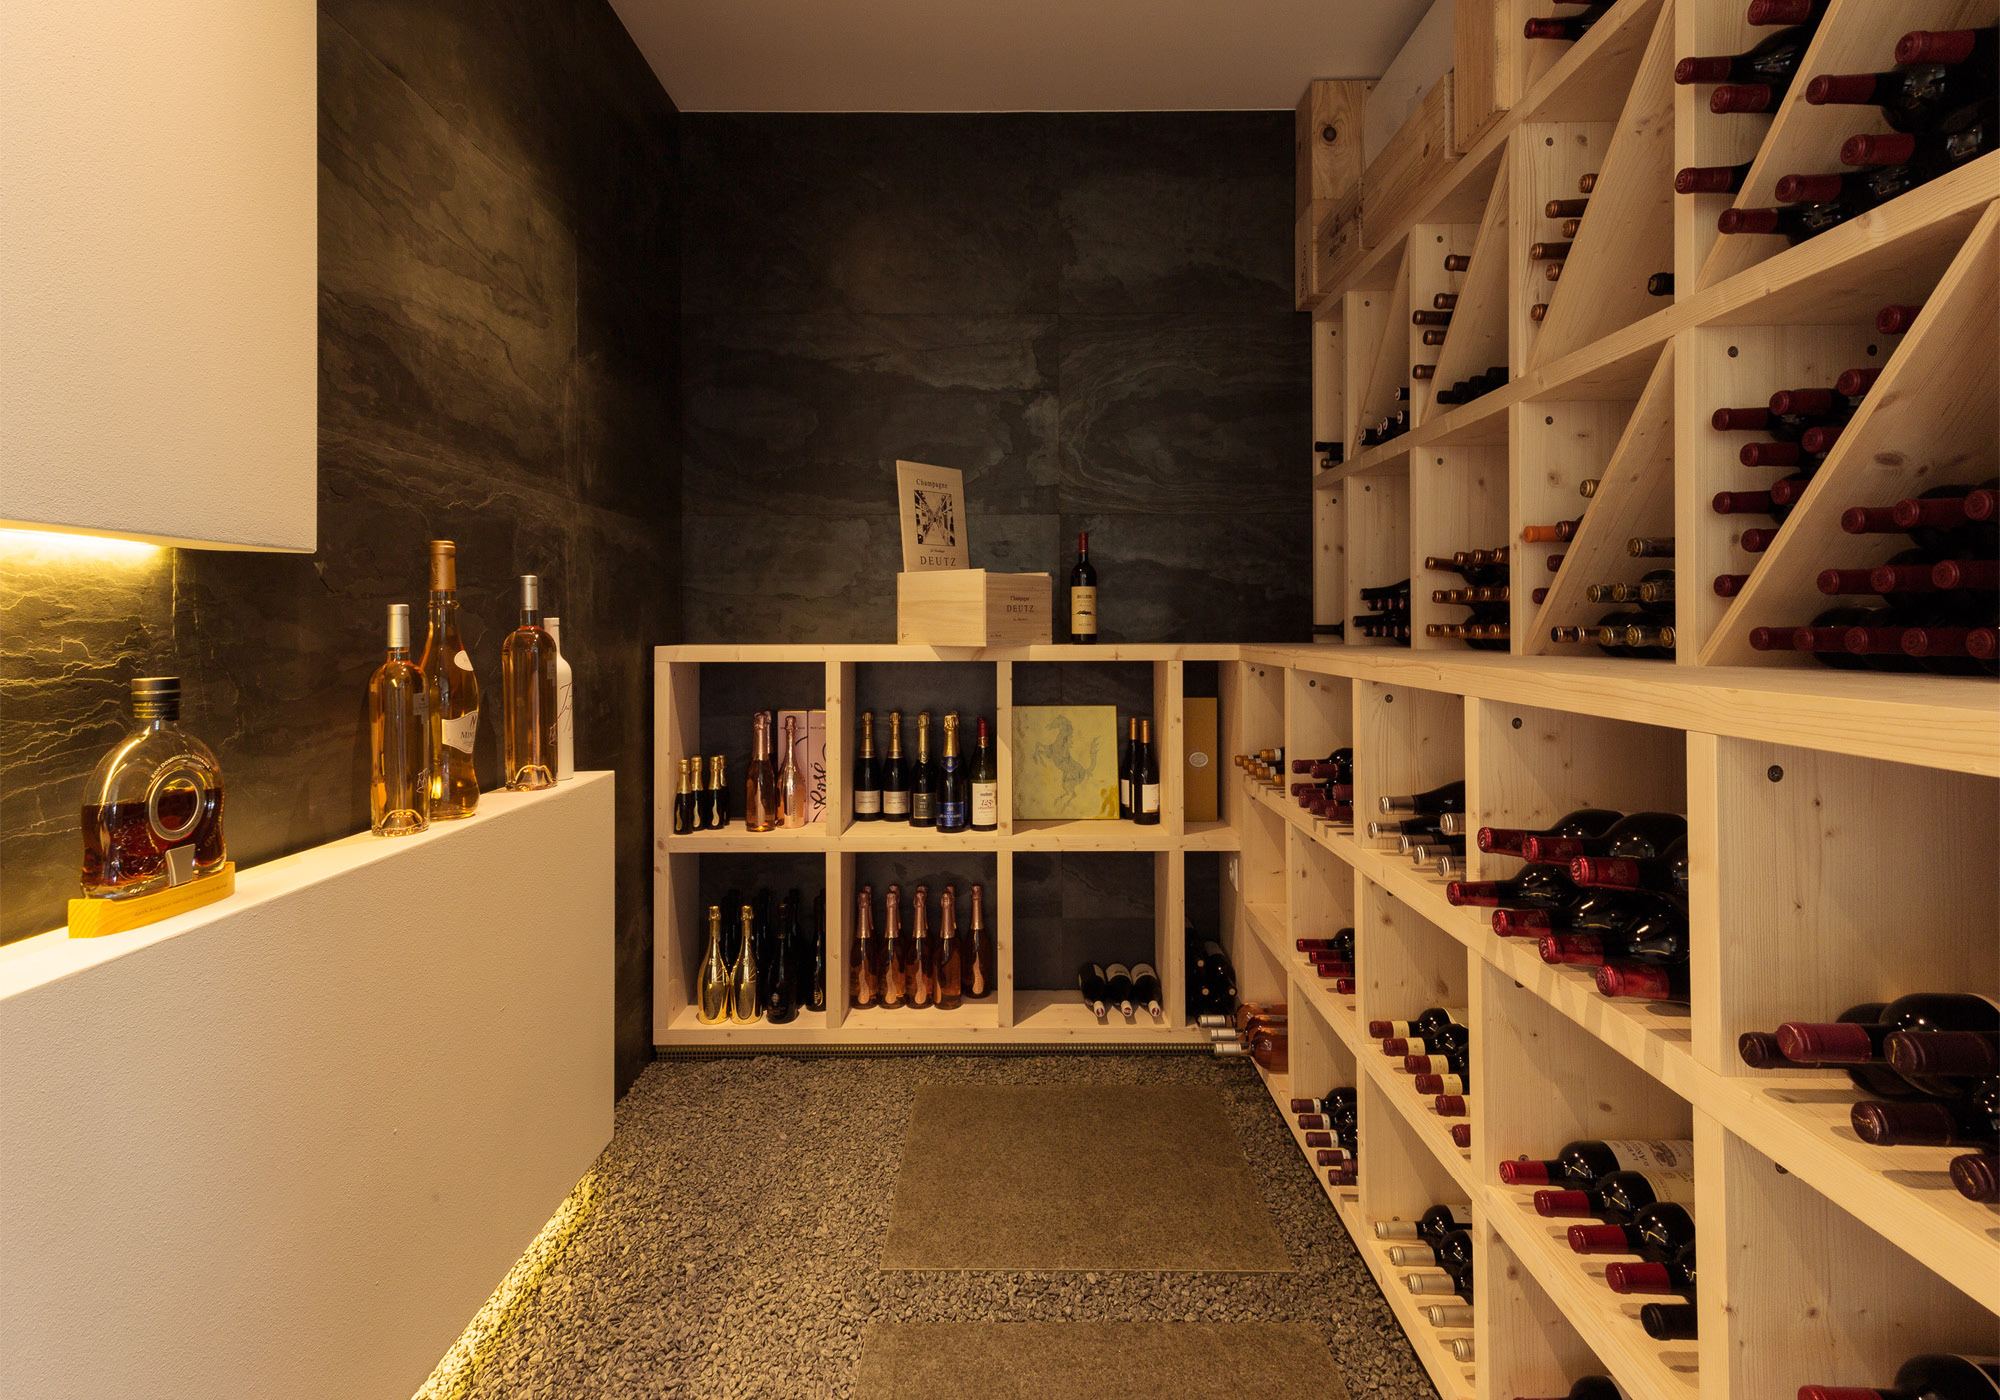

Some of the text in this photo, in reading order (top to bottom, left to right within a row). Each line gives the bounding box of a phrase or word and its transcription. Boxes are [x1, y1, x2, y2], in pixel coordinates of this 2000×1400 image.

[916, 478, 948, 489] Champagne
[920, 556, 957, 567] DEUTZ
[1006, 604, 1034, 613] DEUTZ
